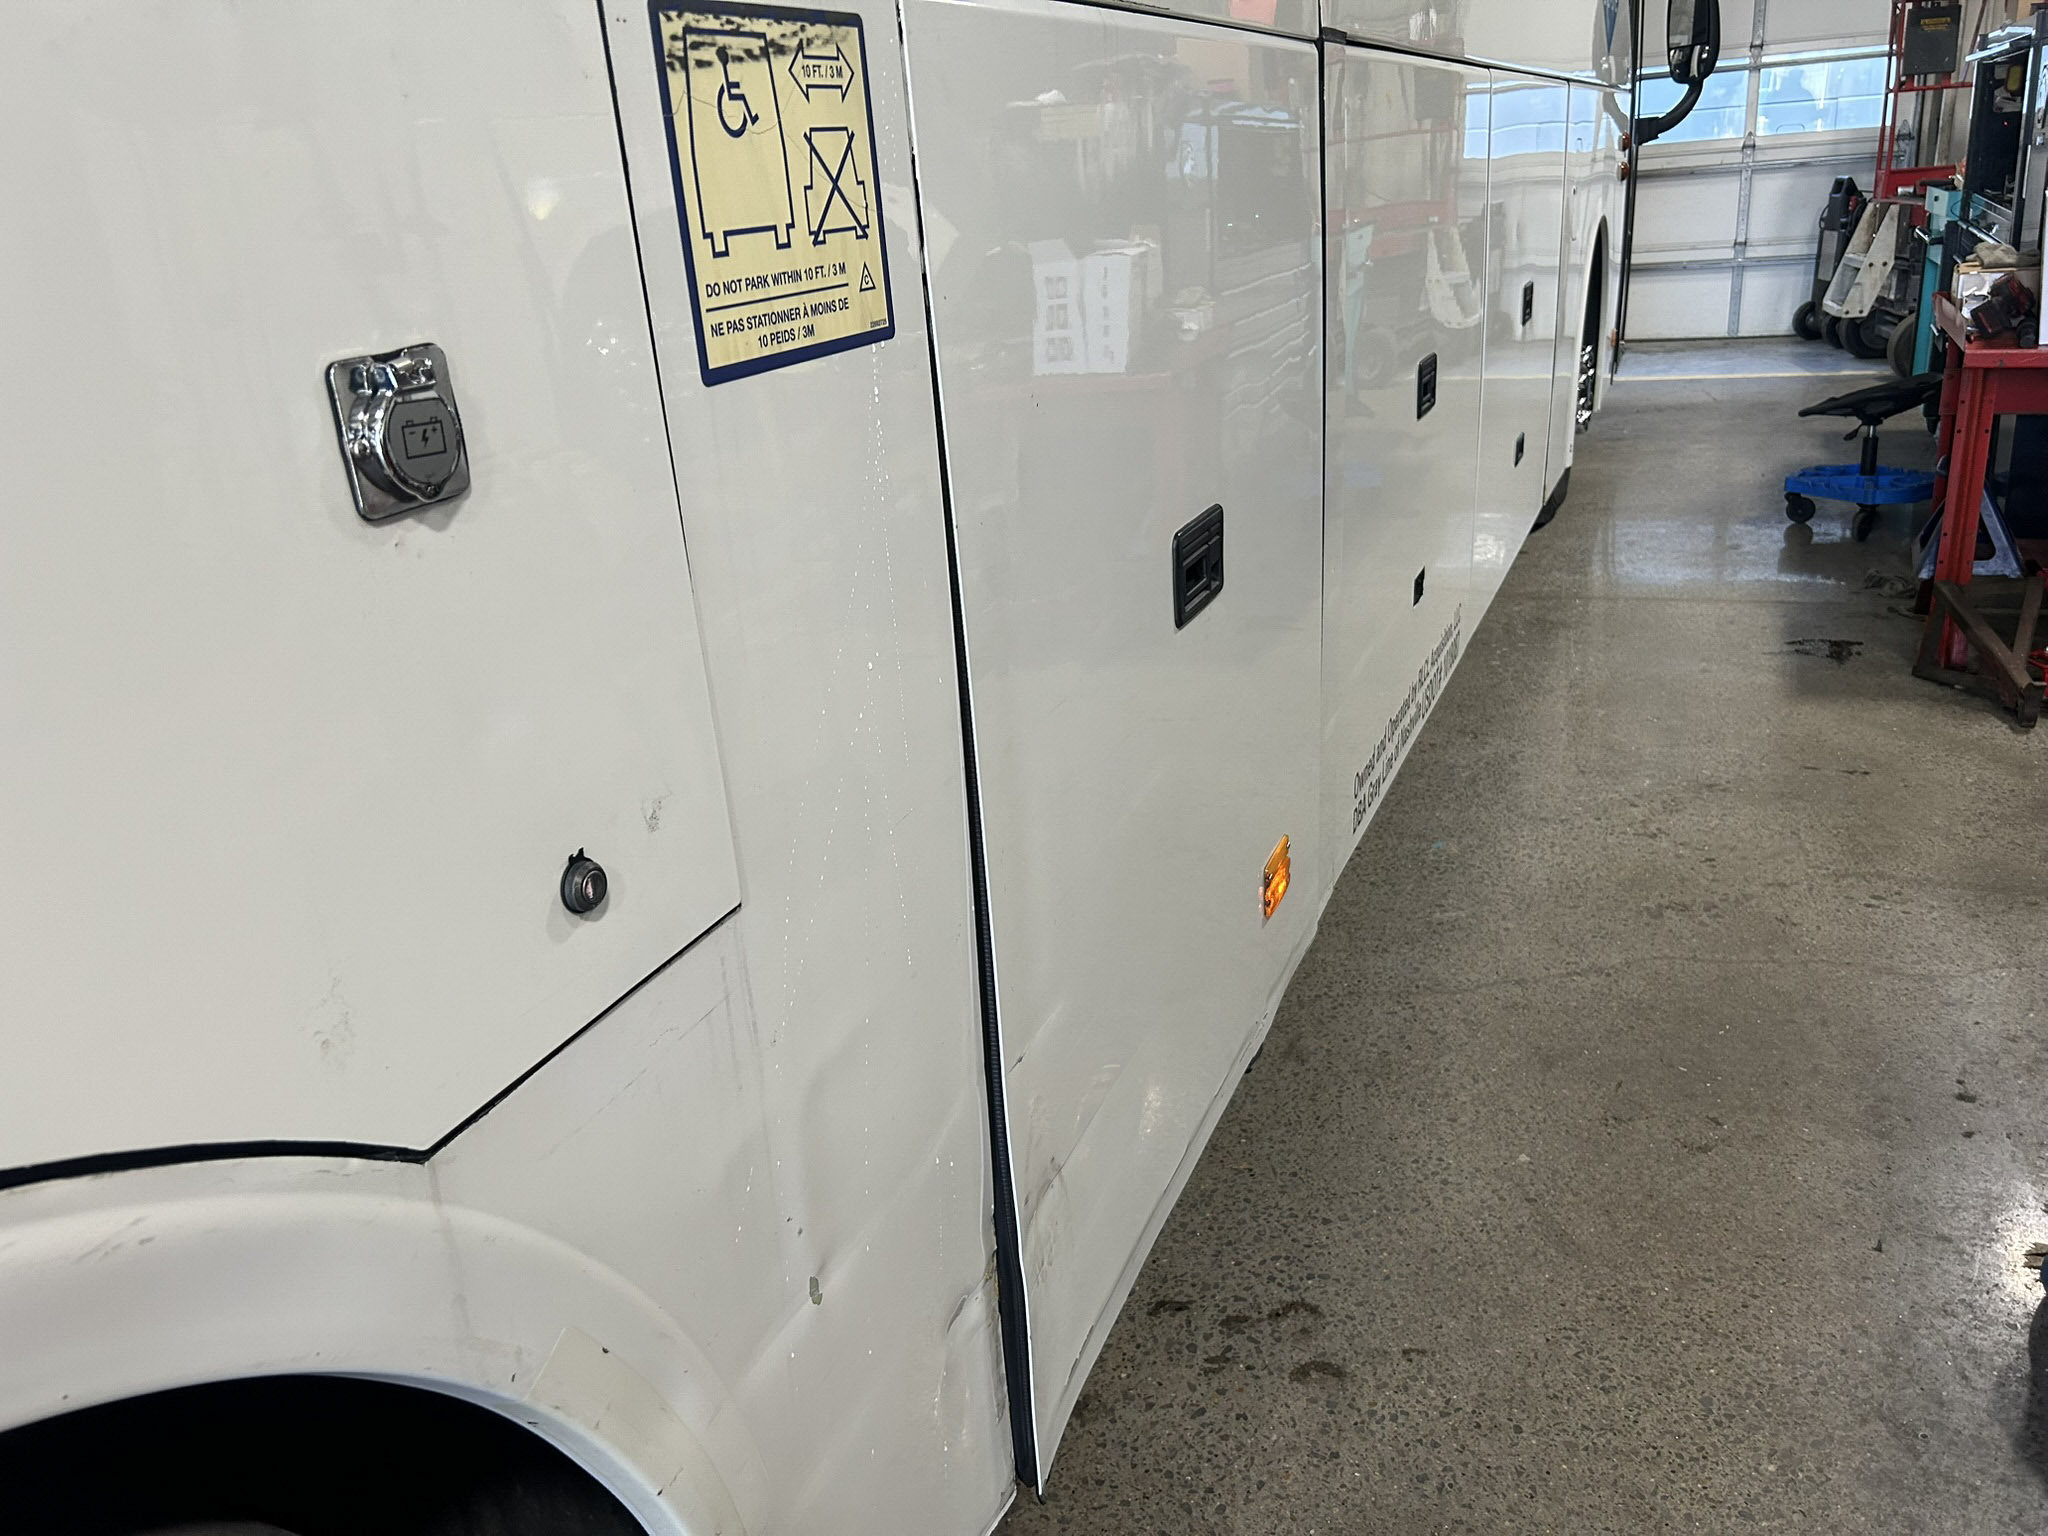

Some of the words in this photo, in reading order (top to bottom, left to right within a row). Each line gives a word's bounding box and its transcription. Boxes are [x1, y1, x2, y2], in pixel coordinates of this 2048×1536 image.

[802, 64, 811, 78] 10
[812, 64, 823, 78] FT.
[829, 65, 835, 78] 3
[836, 65, 843, 78] M
[706, 283, 720, 298] DO
[723, 279, 742, 295] NOT
[745, 274, 770, 291] PARK
[771, 269, 803, 286] WITHIN
[804, 267, 814, 281] 10
[815, 266, 826, 279] FT.
[832, 264, 838, 277] 3
[839, 262, 846, 275] M
[710, 322, 725, 337] NE
[727, 318, 745, 334] PAS
[746, 307, 801, 331] STATIONNER
[802, 303, 810, 319] À
[810, 302, 836, 317] MOINS
[838, 297, 849, 311] DE
[758, 334, 768, 349] 10
[770, 329, 796, 346] PEIDS
[802, 324, 815, 339] 3M
[1354, 744, 1375, 799] Owned
[1376, 725, 1387, 763] and
[1387, 684, 1411, 744] Operated
[1410, 681, 1418, 705] by
[1352, 793, 1367, 835] DBA
[1367, 774, 1381, 808] Gray
[1381, 751, 1394, 785] Line
[1394, 733, 1401, 761] of
[1401, 700, 1422, 749] Nashville
